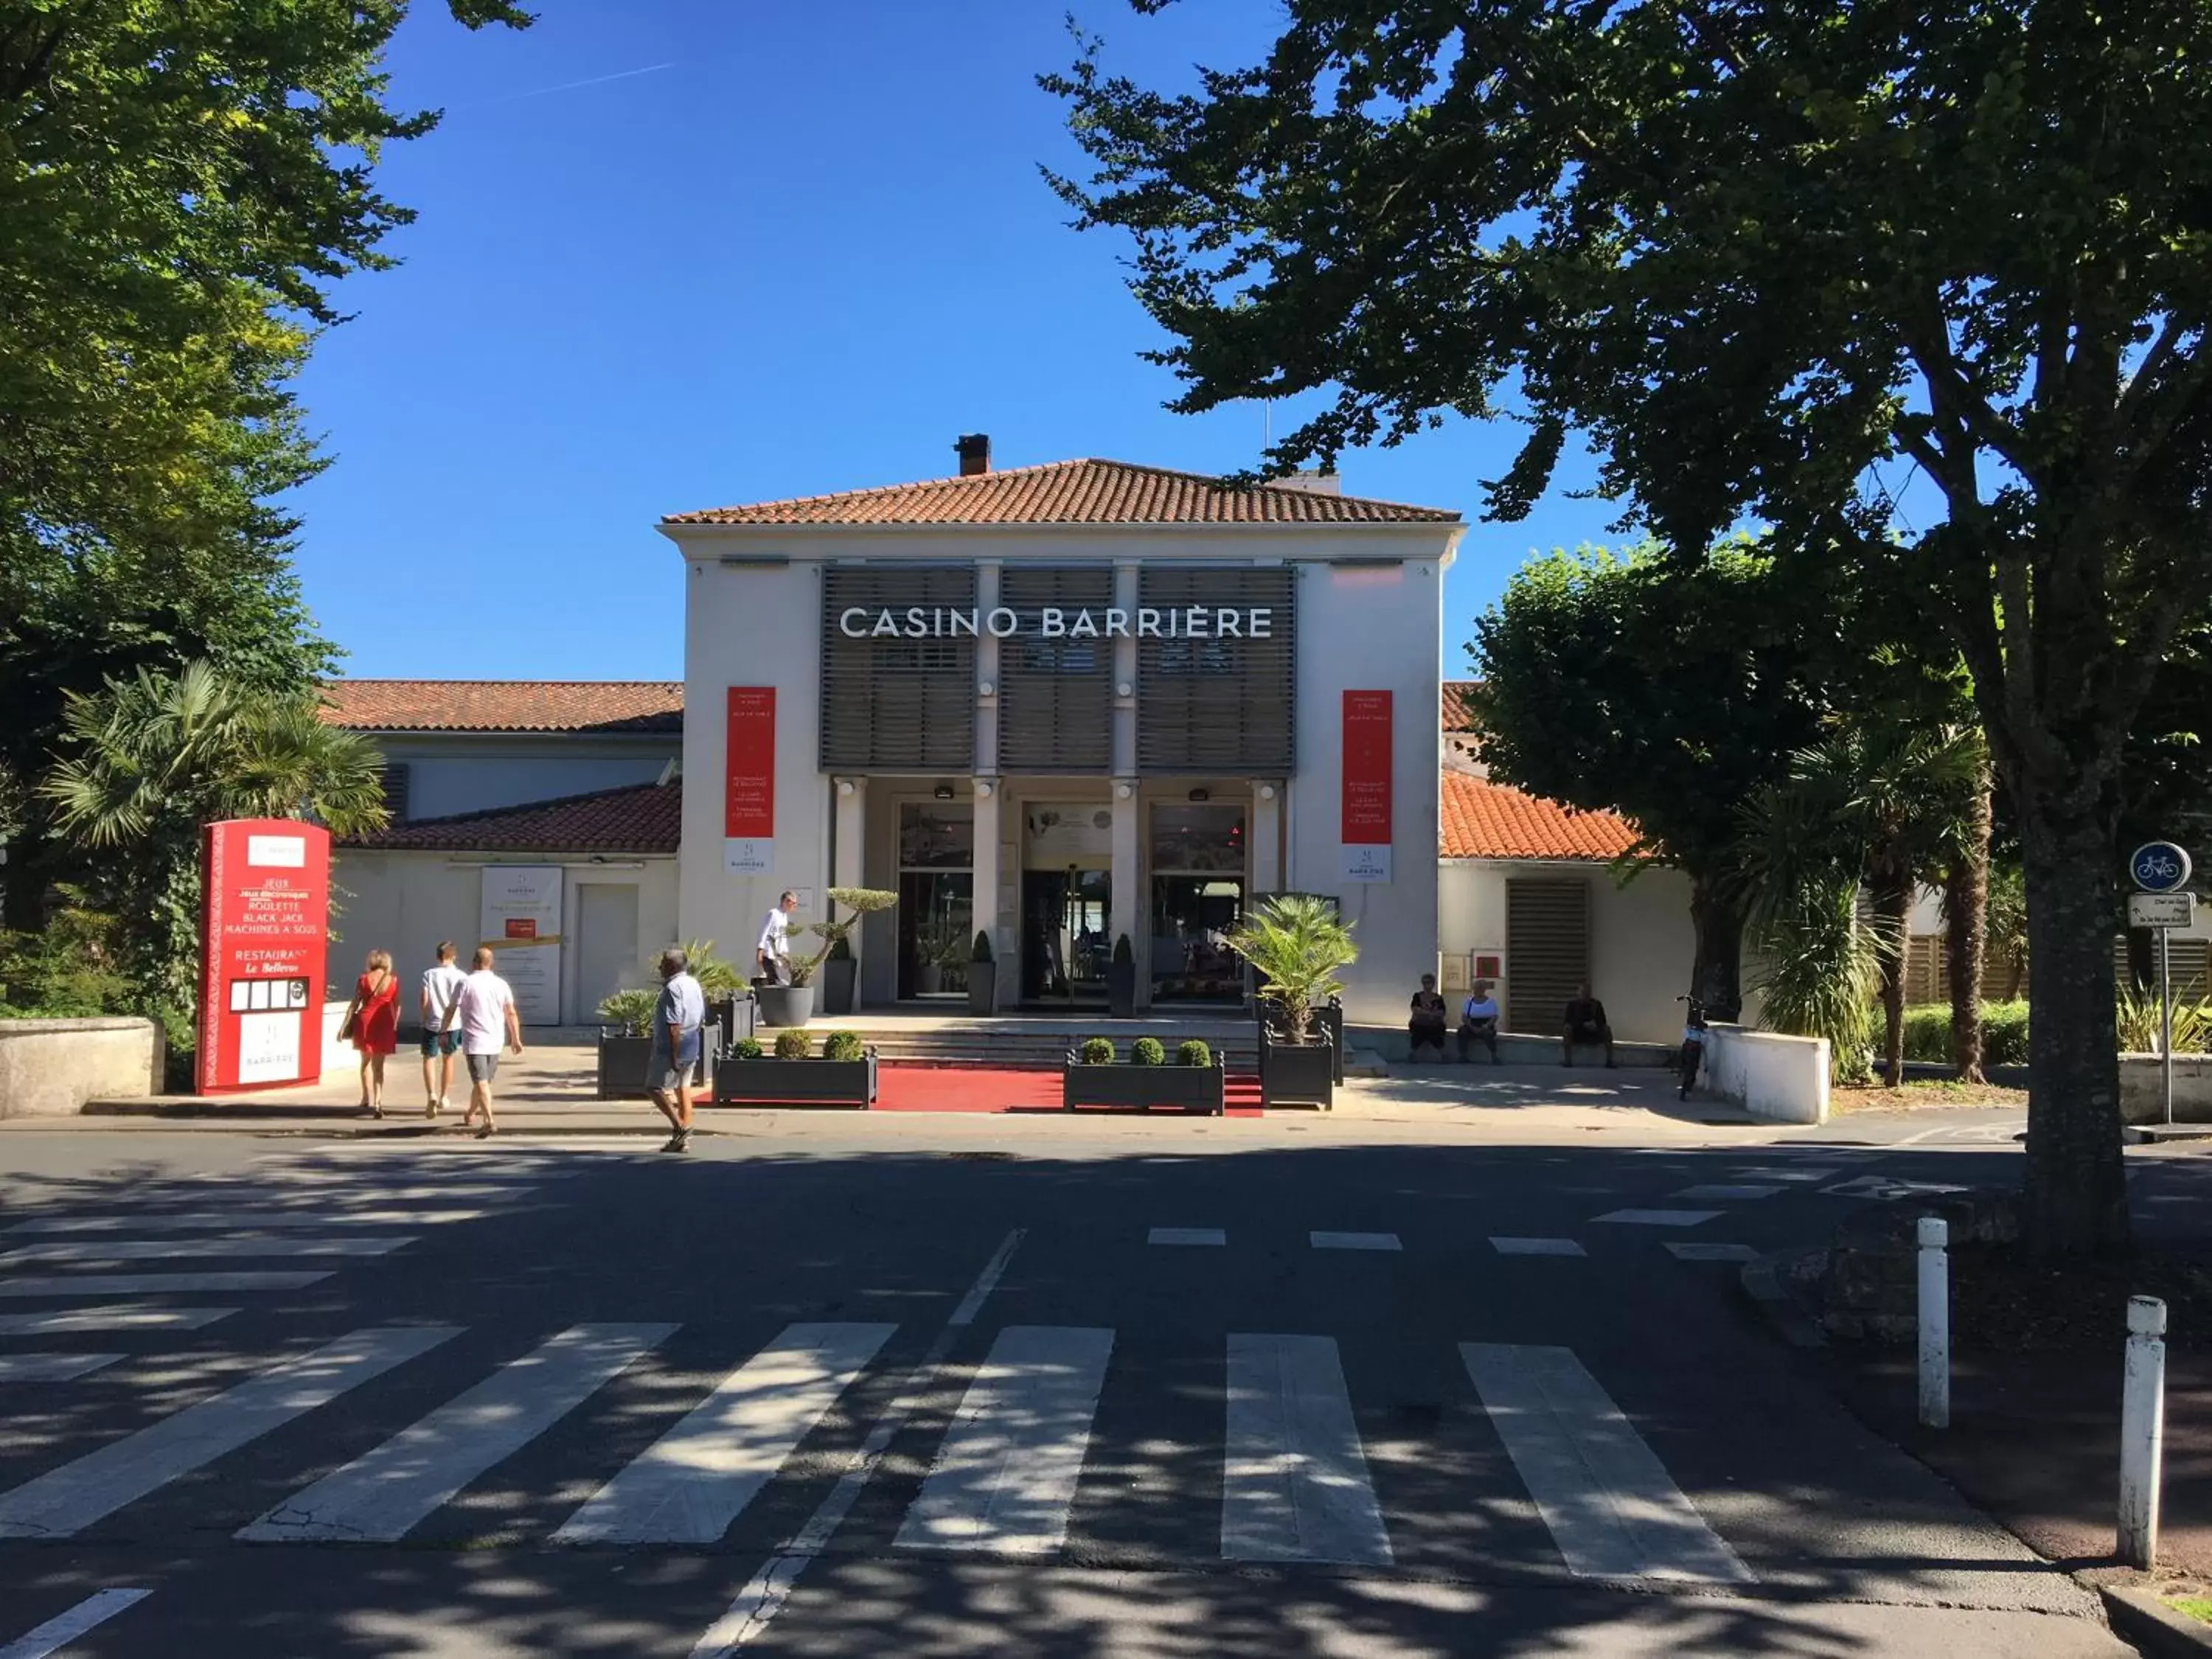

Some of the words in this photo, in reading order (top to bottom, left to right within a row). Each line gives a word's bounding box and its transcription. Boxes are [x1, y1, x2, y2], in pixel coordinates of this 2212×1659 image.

[840, 606, 1018, 639] CASINO
[1041, 604, 1273, 639] BARRIÈRE
[264, 878, 289, 889] JEUX
[248, 902, 299, 912] ROULETTE
[243, 913, 276, 922] BLACK
[279, 914, 304, 923] JACK
[224, 925, 279, 935] MACHINES
[293, 925, 318, 935] SOUS
